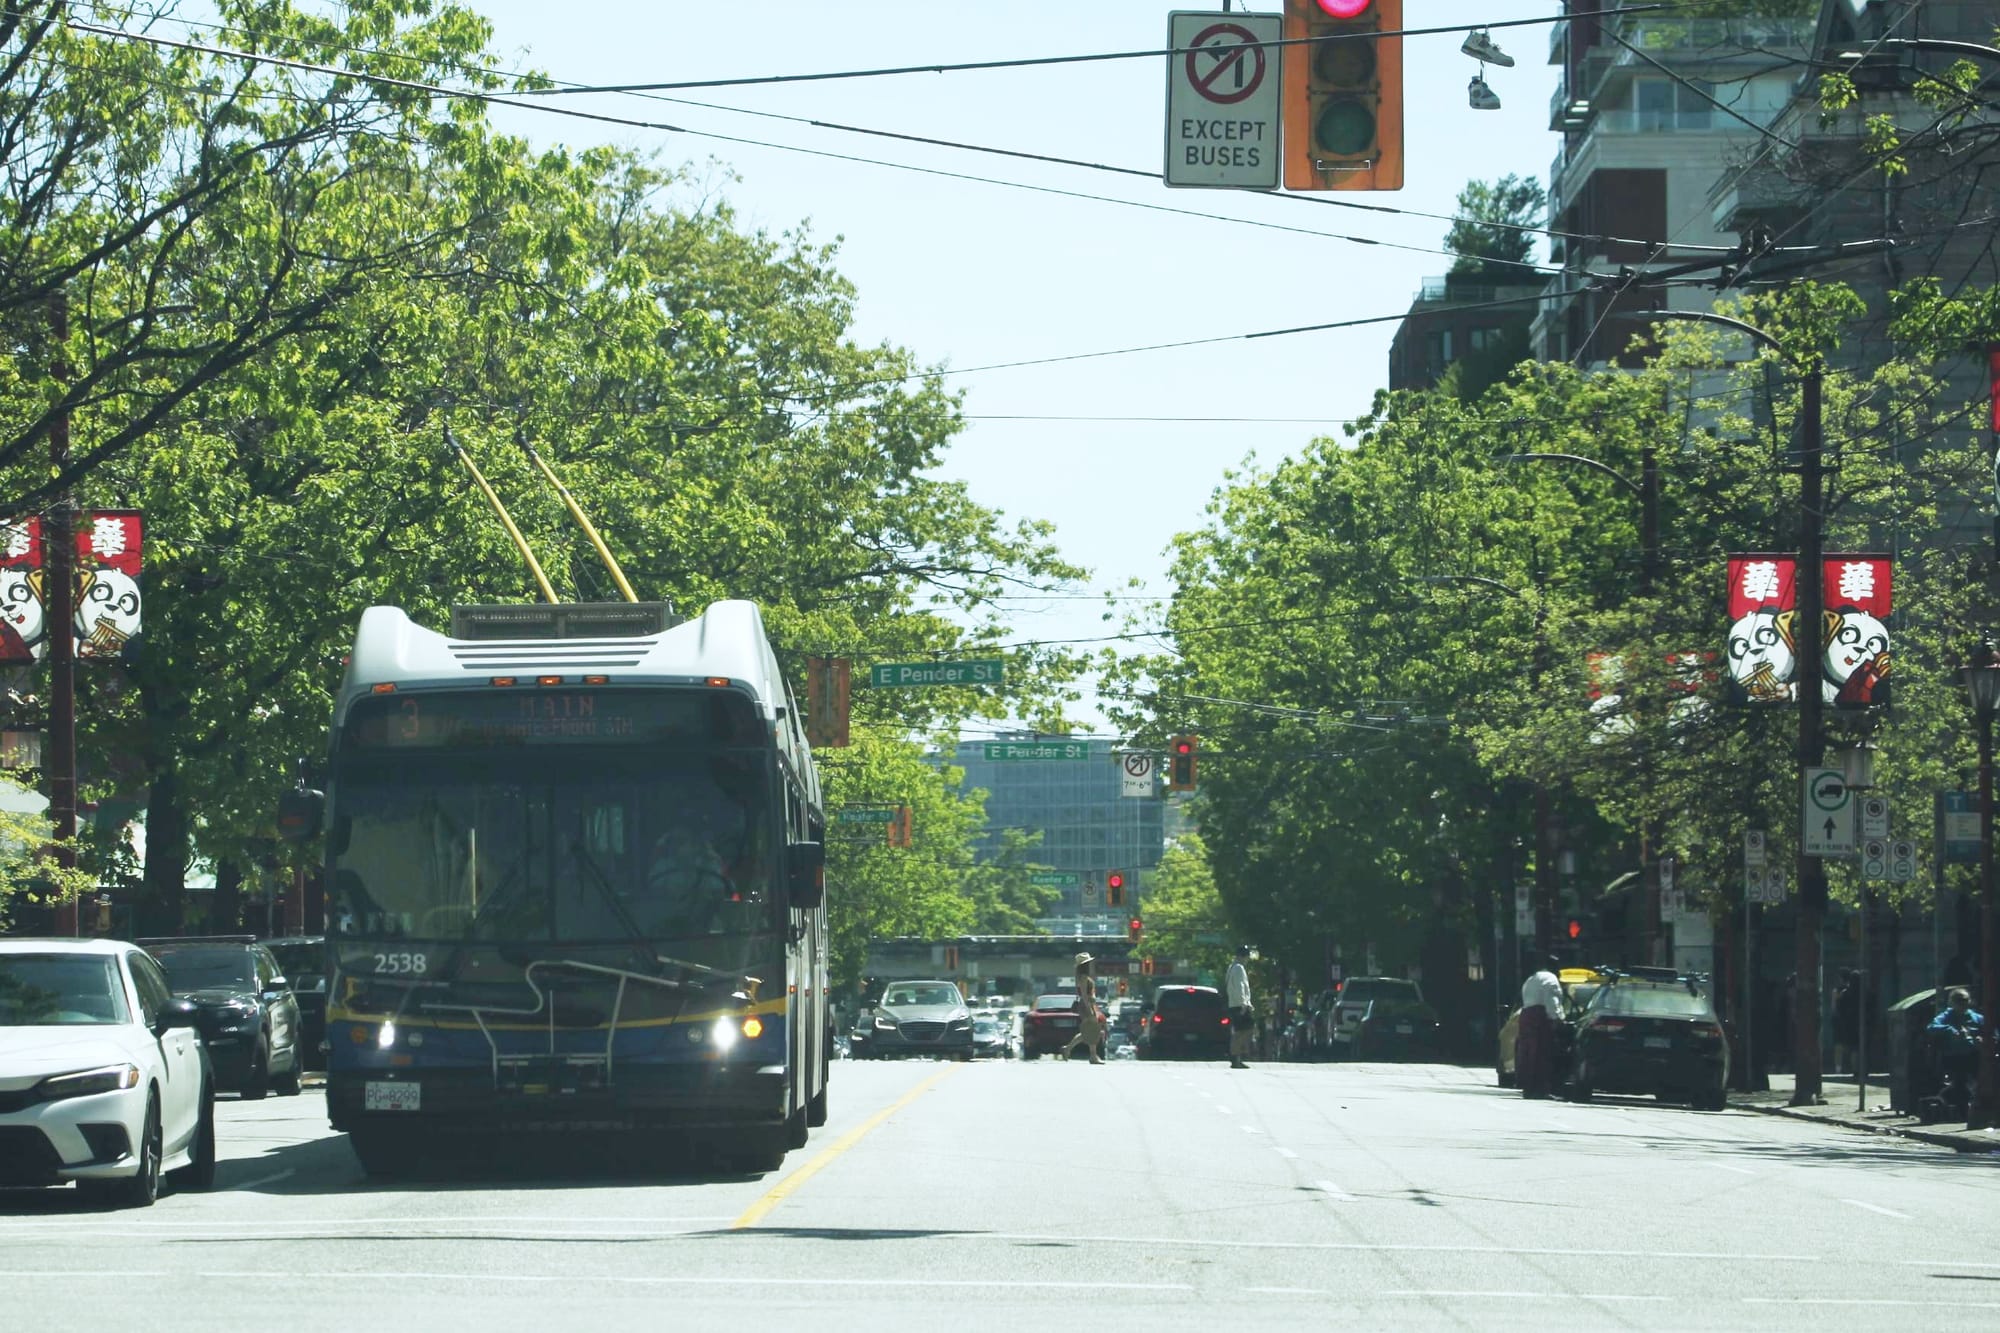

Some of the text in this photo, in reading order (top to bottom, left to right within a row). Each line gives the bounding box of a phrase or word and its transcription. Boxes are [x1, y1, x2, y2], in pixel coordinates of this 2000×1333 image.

[1181, 118, 1266, 142] EXCEPT
[1185, 145, 1261, 167] BUSES
[90, 517, 128, 558] 華
[1741, 561, 1780, 602] 華
[1837, 561, 1875, 602] 華
[880, 664, 993, 684] E Pender St
[520, 694, 595, 717] MAIN
[400, 696, 420, 739] 3
[991, 744, 1081, 758] E Pender St
[374, 952, 427, 974] 2538
